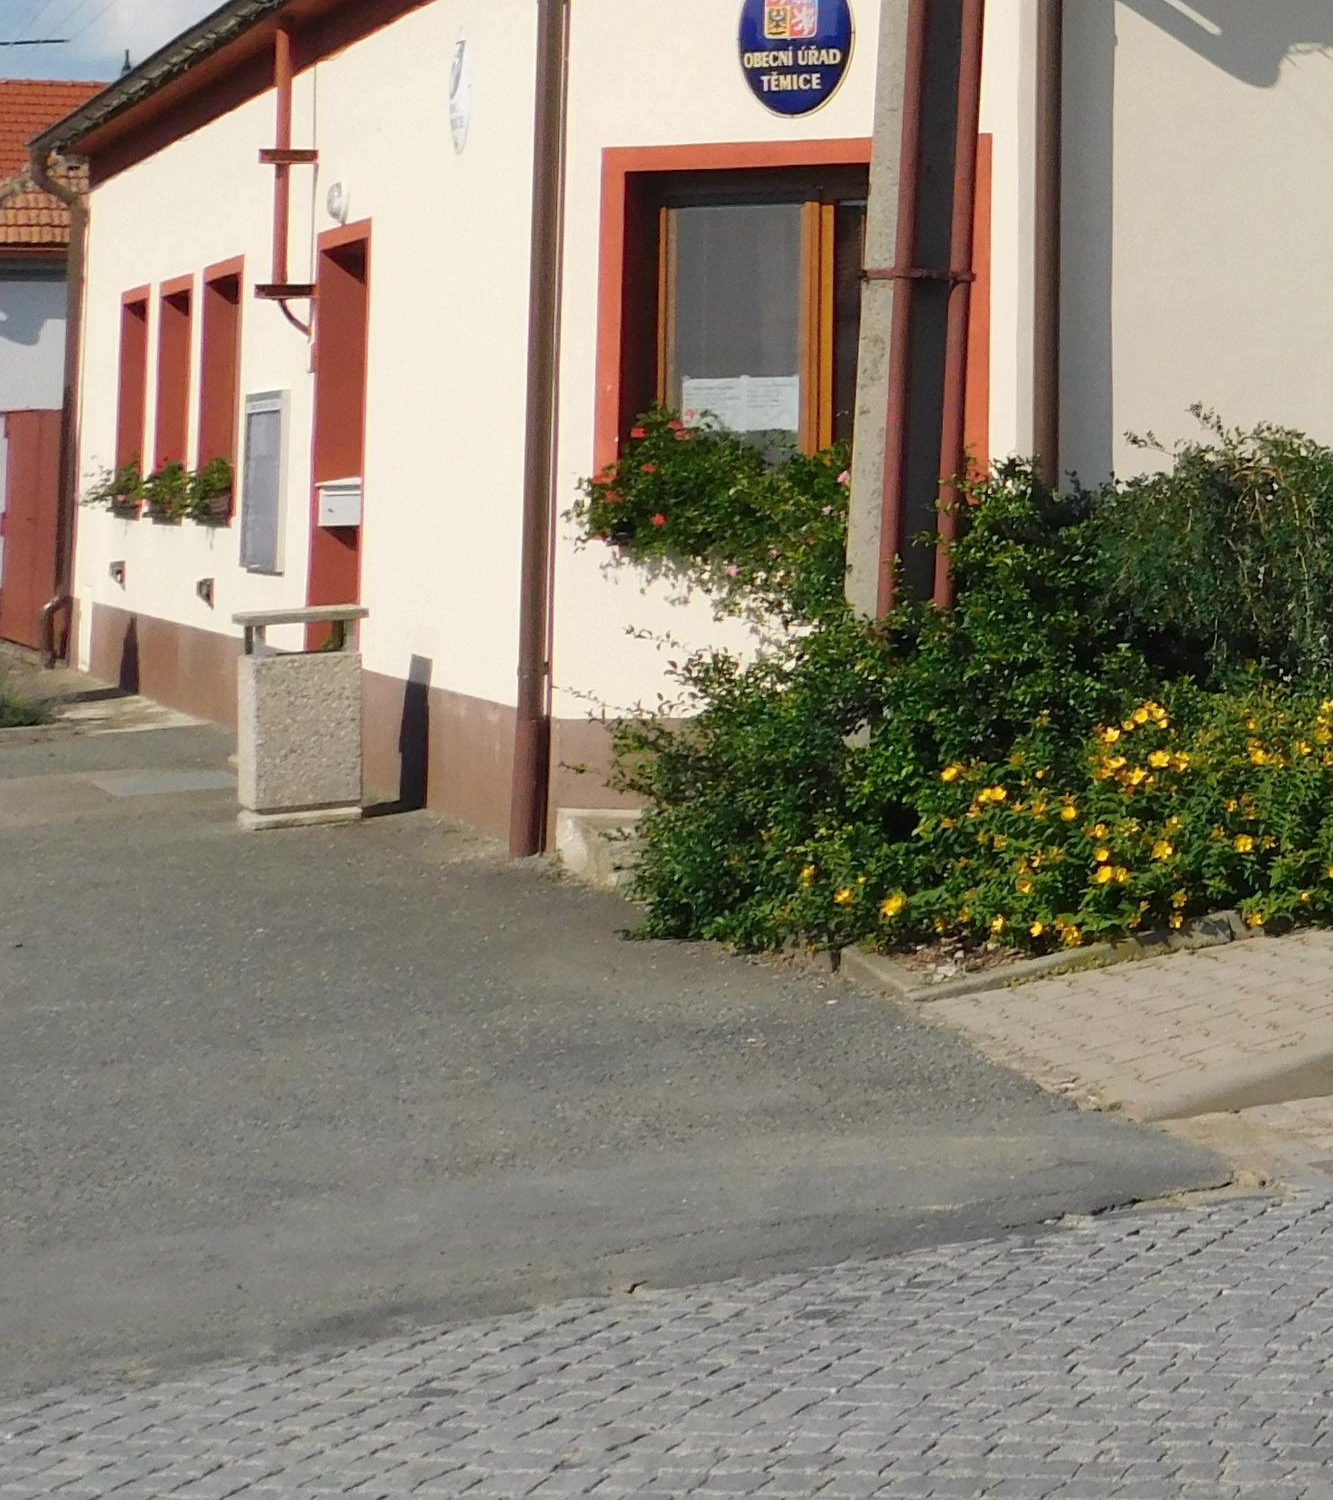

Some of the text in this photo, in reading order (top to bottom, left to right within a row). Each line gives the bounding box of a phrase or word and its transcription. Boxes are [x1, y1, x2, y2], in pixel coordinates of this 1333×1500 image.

[743, 45, 841, 69] OBECNÍ ÚŘAD
[760, 71, 821, 92] TĚMICE
